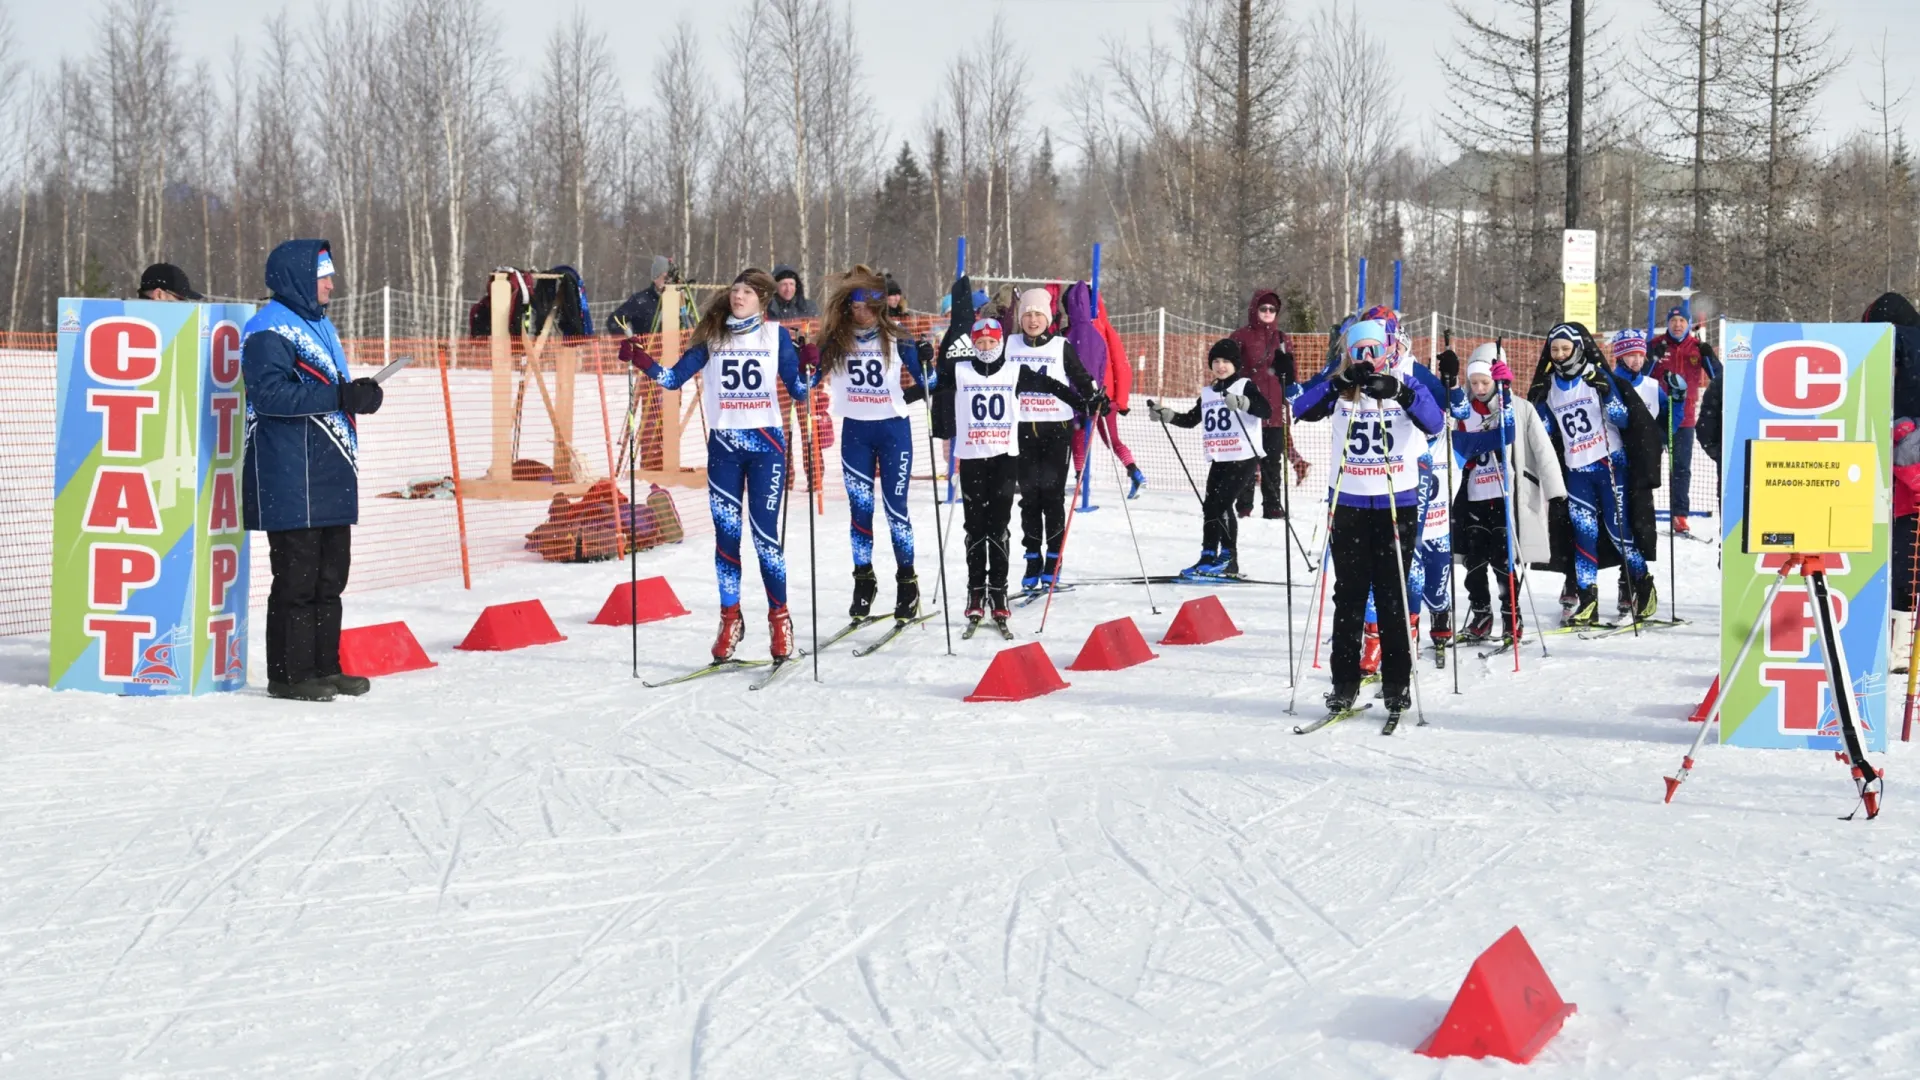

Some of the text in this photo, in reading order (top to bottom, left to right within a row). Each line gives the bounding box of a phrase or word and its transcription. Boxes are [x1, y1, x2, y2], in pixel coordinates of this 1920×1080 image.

[946, 348, 977, 359] adida
[721, 359, 762, 390] 56
[847, 359, 884, 388] 58
[720, 401, 772, 410] АБЫТНАНГИ
[971, 393, 1006, 420] 60
[1204, 407, 1232, 432] 68
[1349, 420, 1395, 455] 55
[1562, 407, 1593, 439] 63
[894, 451, 909, 497] ЯМАЛ
[1765, 461, 1840, 470] WWW.MARATHON-E.RU
[766, 463, 782, 512] ЯМАЛ
[1765, 479, 1841, 488] МАРАФОН-ЭЛЕКТРО
[86, 318, 161, 682] СТАРТ
[210, 322, 241, 679] СТАРТ
[1761, 344, 1845, 732] СРТ
